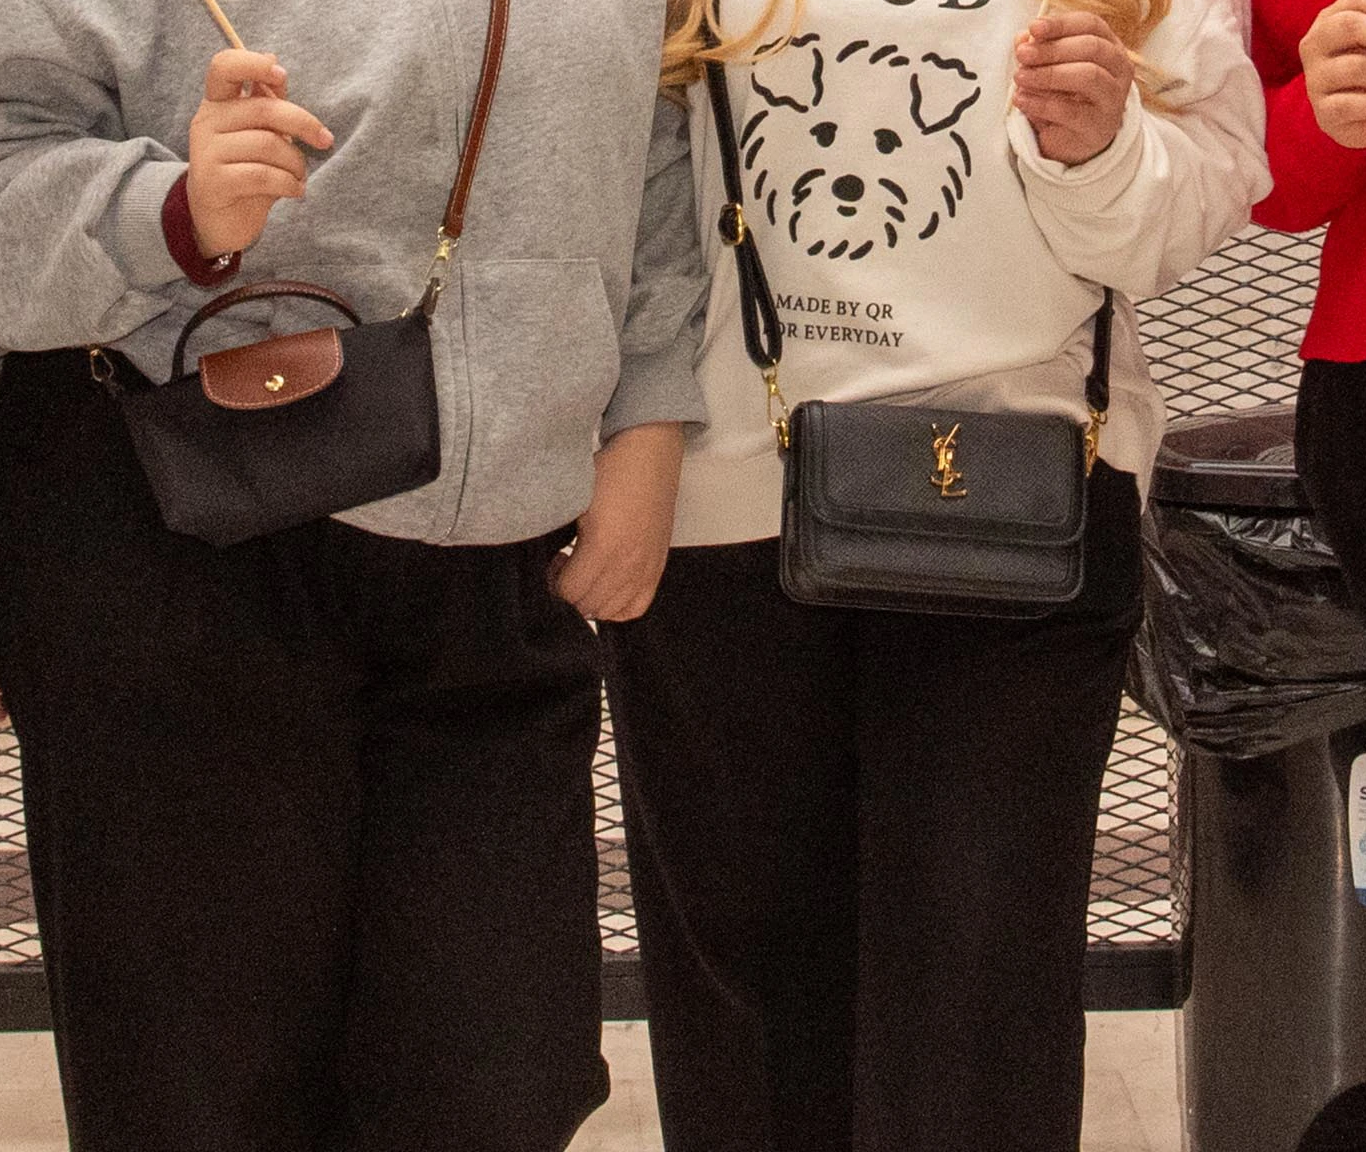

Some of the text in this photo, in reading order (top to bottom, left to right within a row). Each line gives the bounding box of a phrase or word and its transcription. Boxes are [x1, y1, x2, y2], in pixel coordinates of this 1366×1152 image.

[776, 294, 894, 322] MADE BY QR
[769, 321, 904, 348] OR EVERYDAY
